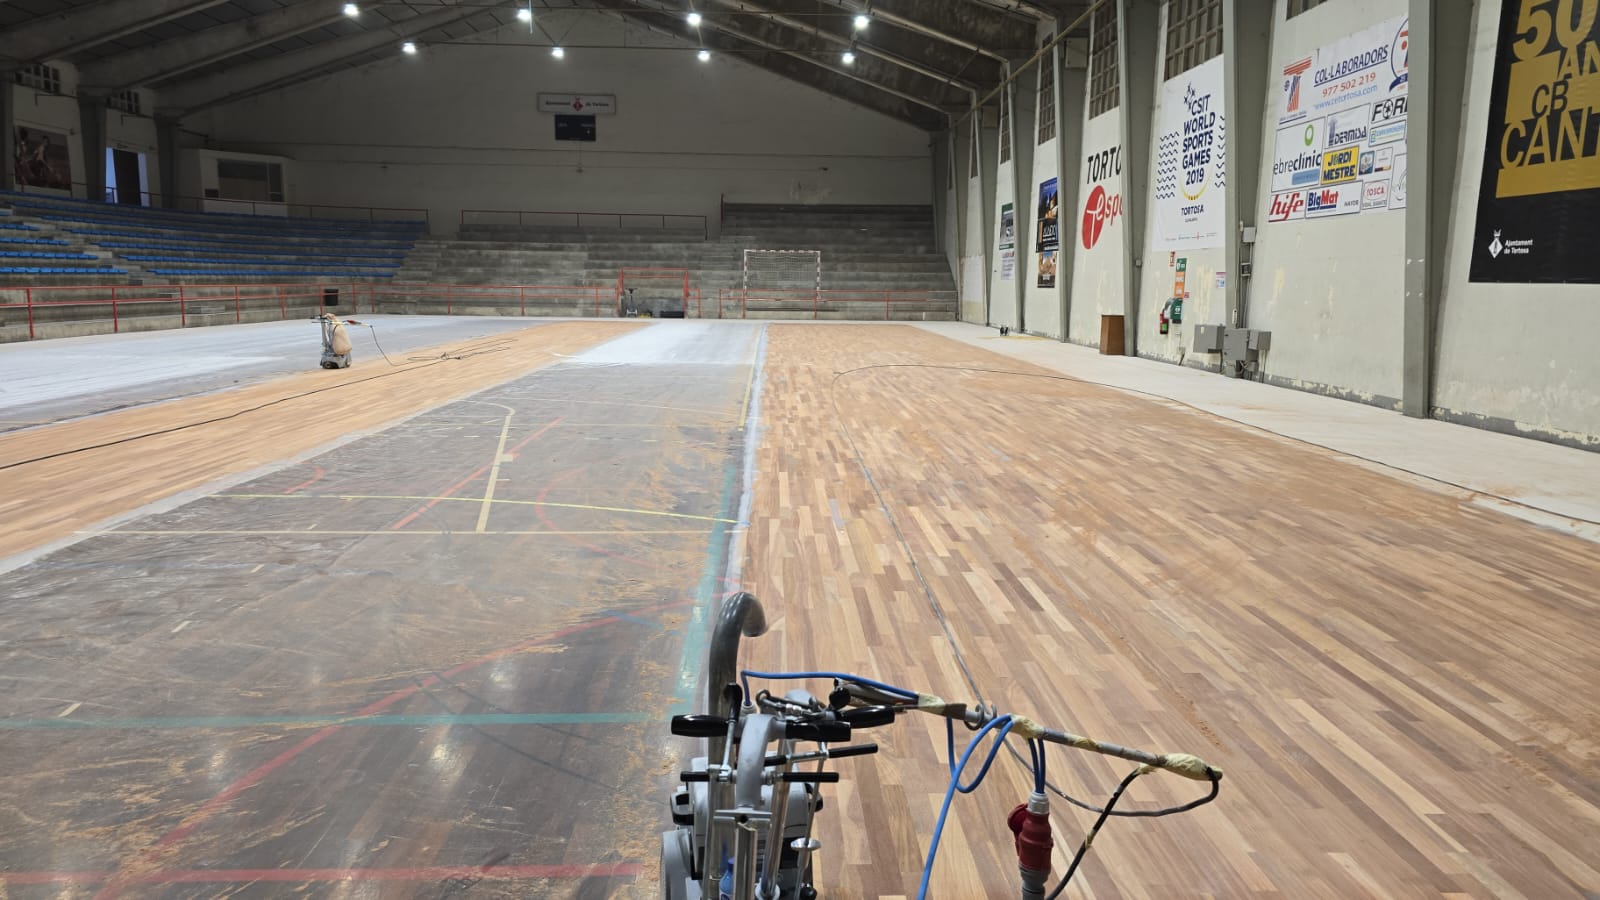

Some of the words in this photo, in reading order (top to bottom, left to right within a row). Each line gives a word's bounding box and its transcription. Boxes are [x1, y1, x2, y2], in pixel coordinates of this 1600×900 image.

[1513, 0, 1598, 60] 50
[1322, 85, 1338, 98] 977
[1340, 79, 1357, 93] 502
[1357, 72, 1376, 86] 219
[1191, 95, 1211, 116] CSIT
[1532, 79, 1569, 118] CB
[1183, 112, 1216, 136] WORLD
[1182, 130, 1214, 153] SPORTS
[1182, 149, 1211, 170] GAMES
[1328, 150, 1352, 166] JORDI
[1185, 168, 1205, 186] 2019
[1323, 165, 1356, 181] MESTRE
[1269, 192, 1304, 220] hife
[1307, 189, 1339, 208] BigMat
[1181, 204, 1204, 216] TORTOSA
